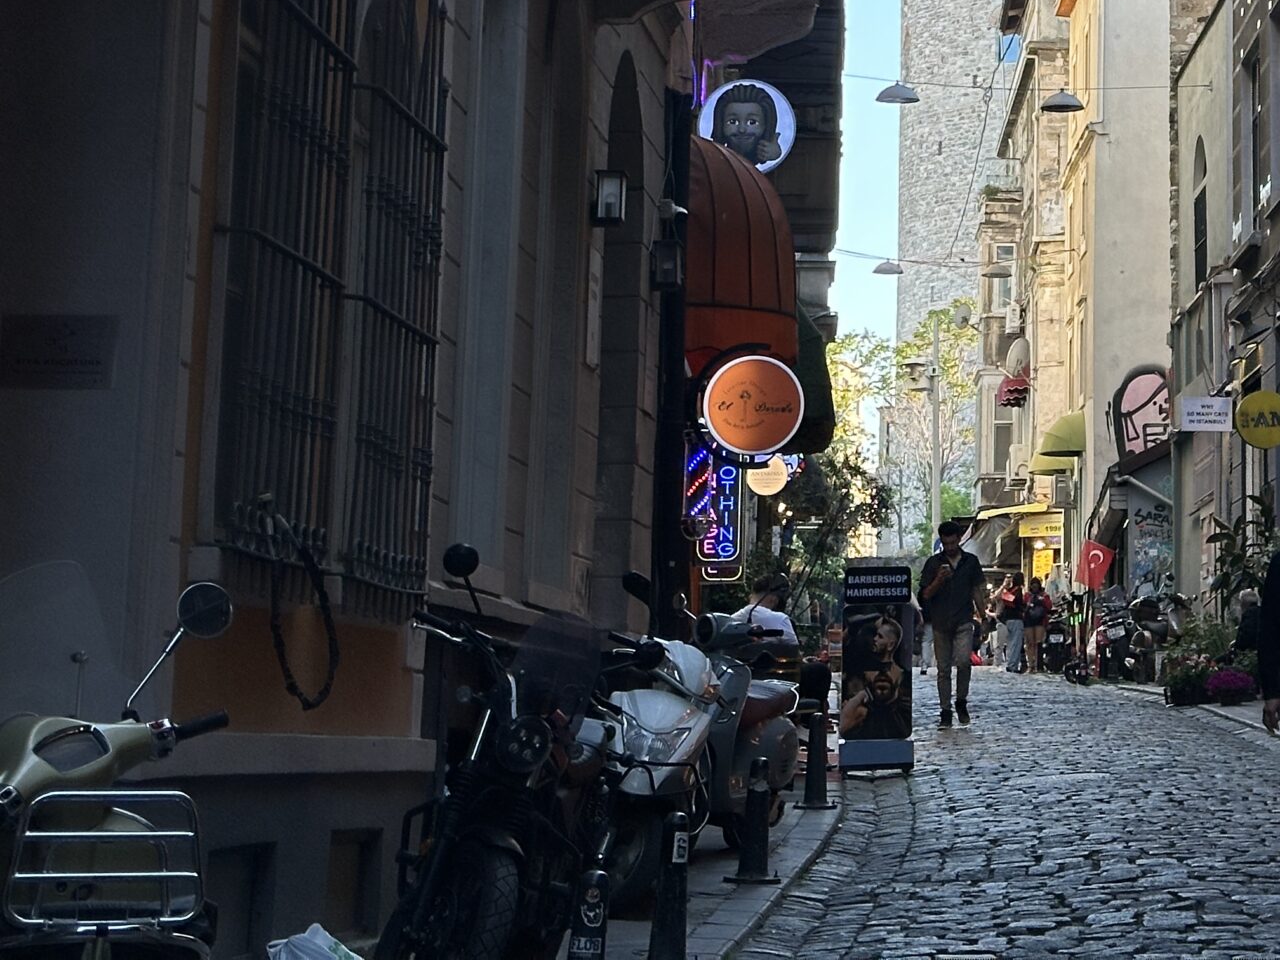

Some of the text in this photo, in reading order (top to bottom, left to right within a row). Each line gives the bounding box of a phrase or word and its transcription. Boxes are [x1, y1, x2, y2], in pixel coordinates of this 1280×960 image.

[720, 466, 737, 556] OTHING
[848, 575, 908, 584] BARBERSHOP
[846, 588, 909, 597] HAIRDRESSER
